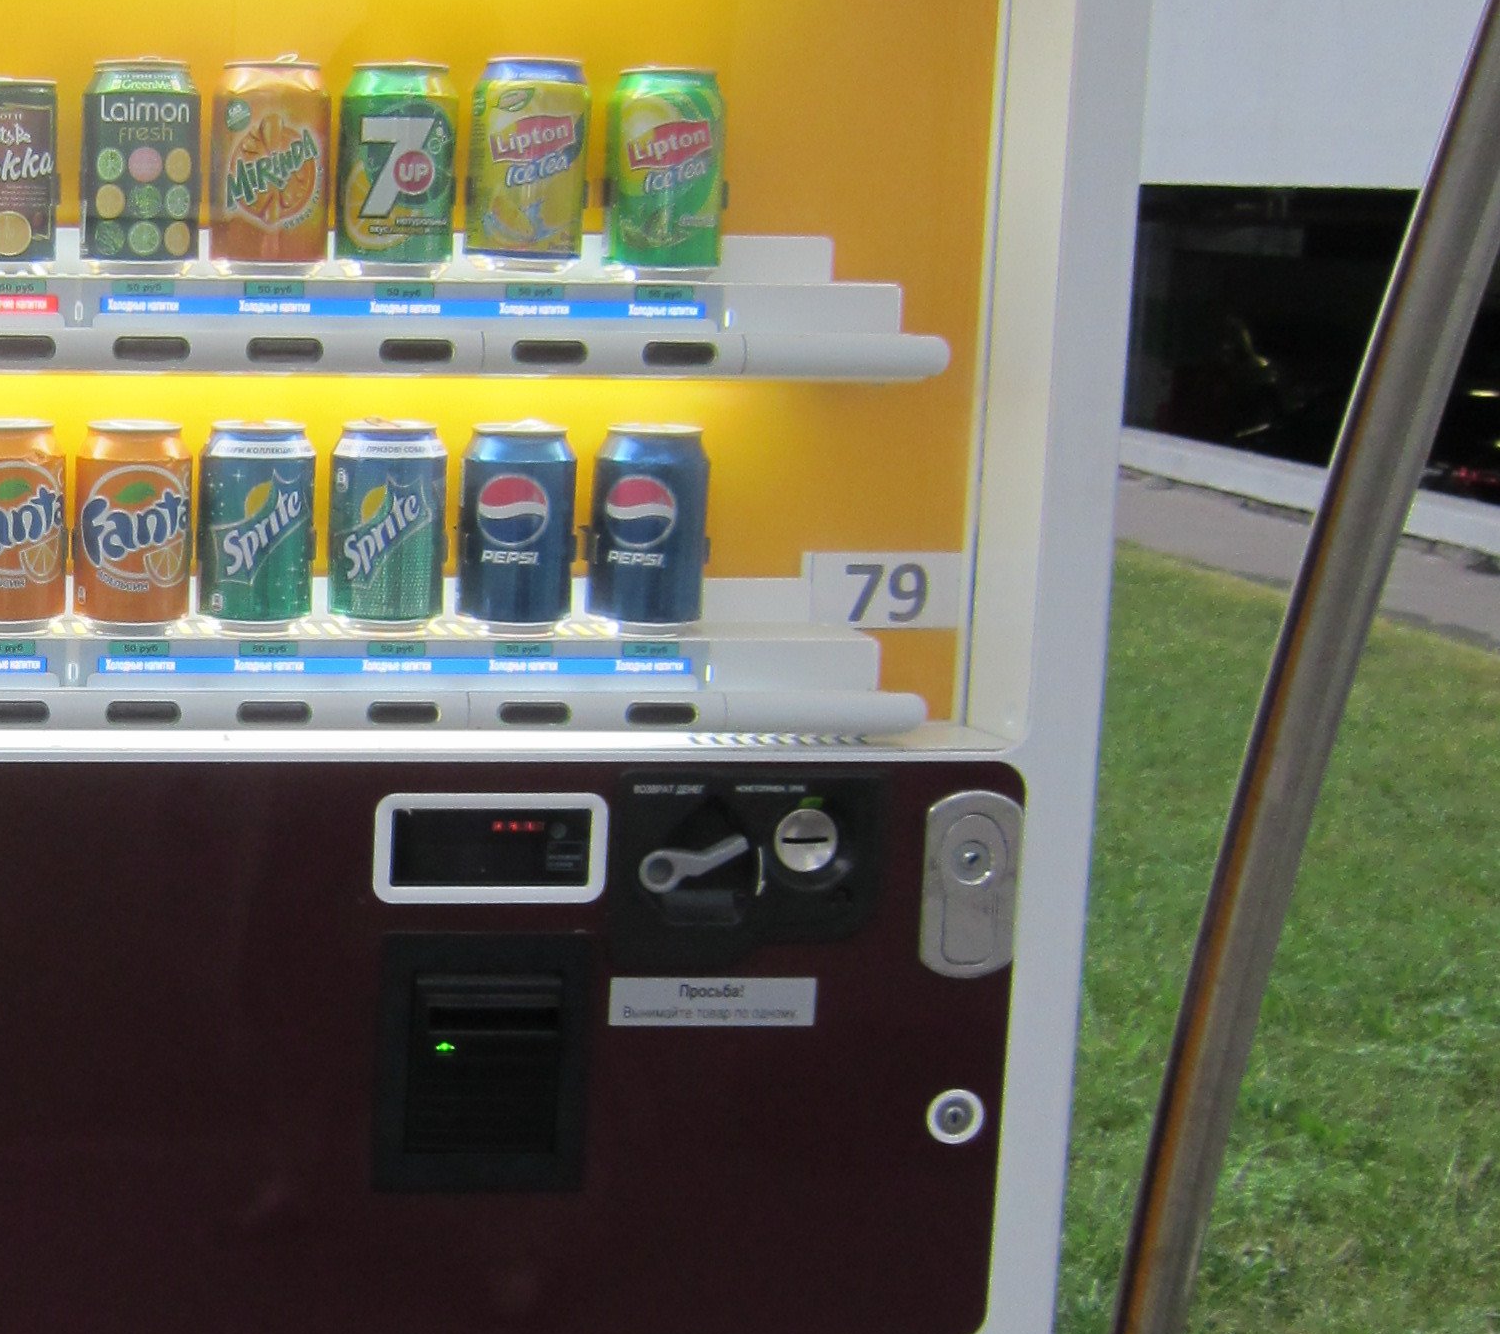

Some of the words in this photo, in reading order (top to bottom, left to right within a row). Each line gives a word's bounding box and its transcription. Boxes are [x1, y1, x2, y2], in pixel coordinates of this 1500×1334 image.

[100, 94, 190, 123] Laimon
[118, 125, 174, 144] fresh
[496, 123, 570, 154] Lipton
[633, 128, 707, 160] Lipton
[359, 116, 436, 219] 7
[398, 163, 429, 182] UP
[222, 488, 302, 577] Sprite
[343, 489, 421, 580] Sprite
[480, 549, 540, 566] PEPSI
[607, 549, 665, 568] PEPSI
[845, 563, 929, 626] 79
[5, 644, 23, 653] руб
[139, 645, 158, 653] руб
[397, 645, 414, 654] руб
[679, 984, 745, 1000] Просьба!
